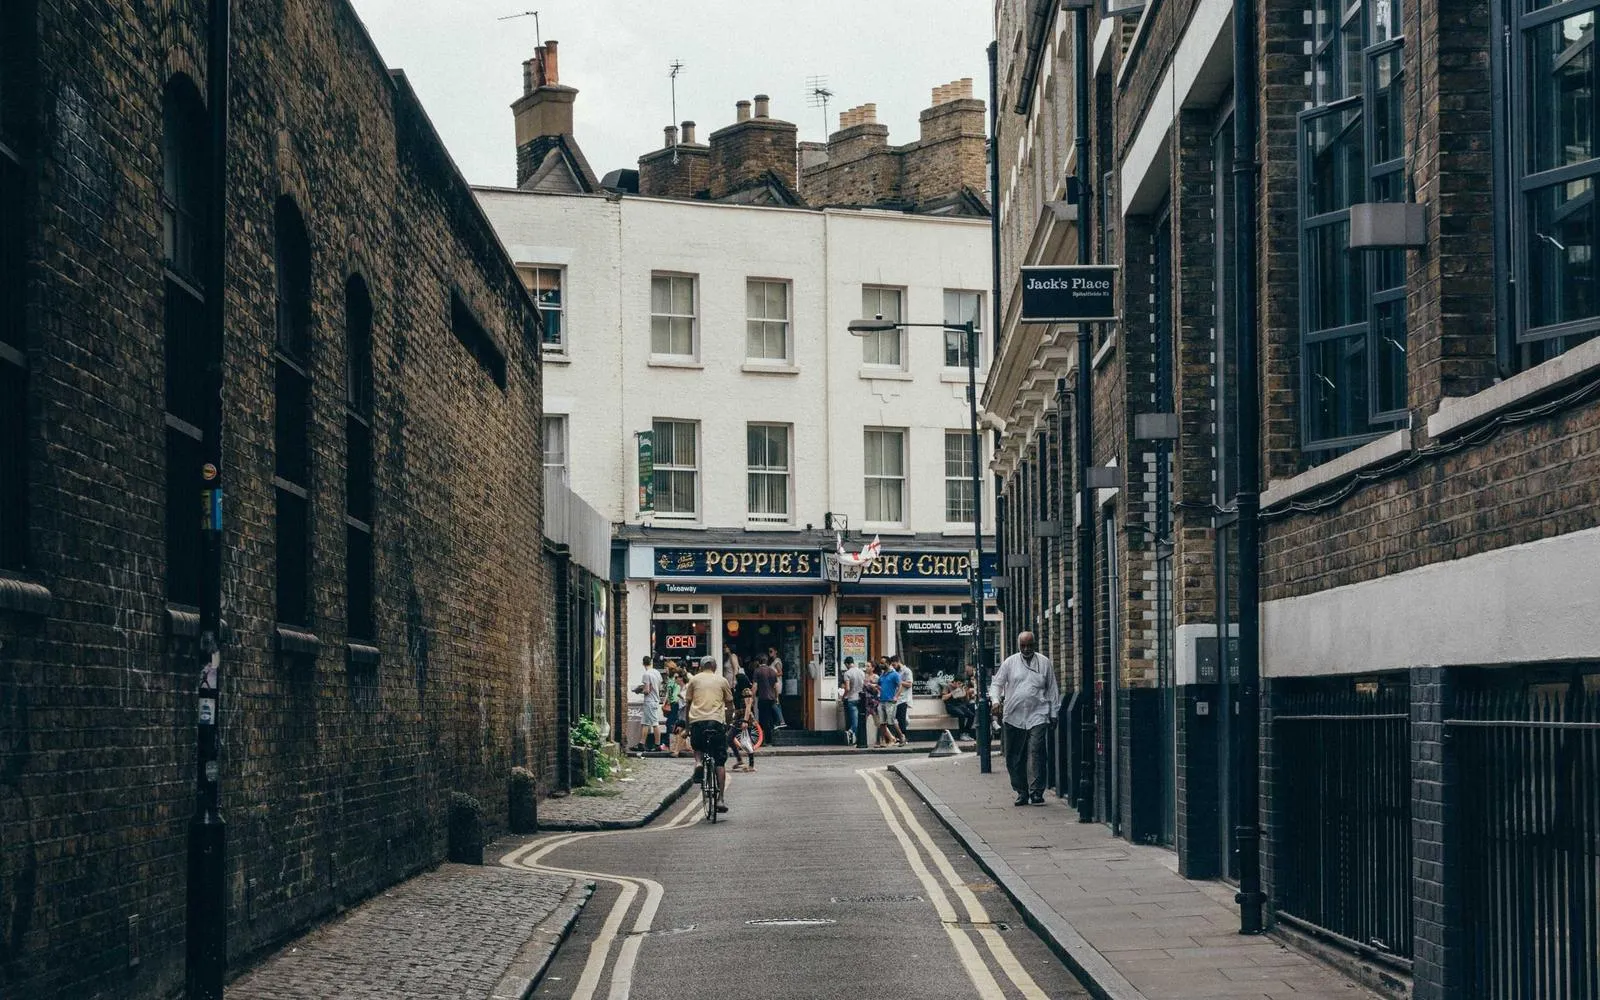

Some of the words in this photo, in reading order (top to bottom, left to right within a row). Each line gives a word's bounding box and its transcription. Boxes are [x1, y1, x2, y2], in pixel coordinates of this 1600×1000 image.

[1027, 277, 1068, 290] Jack's
[1071, 278, 1110, 289] Place
[705, 551, 810, 574] POPPIE'S
[903, 556, 914, 572] &
[917, 554, 971, 576] CHIP
[843, 571, 858, 579] CHIPS
[665, 584, 697, 594] Takeaway
[667, 636, 696, 648] OPEN
